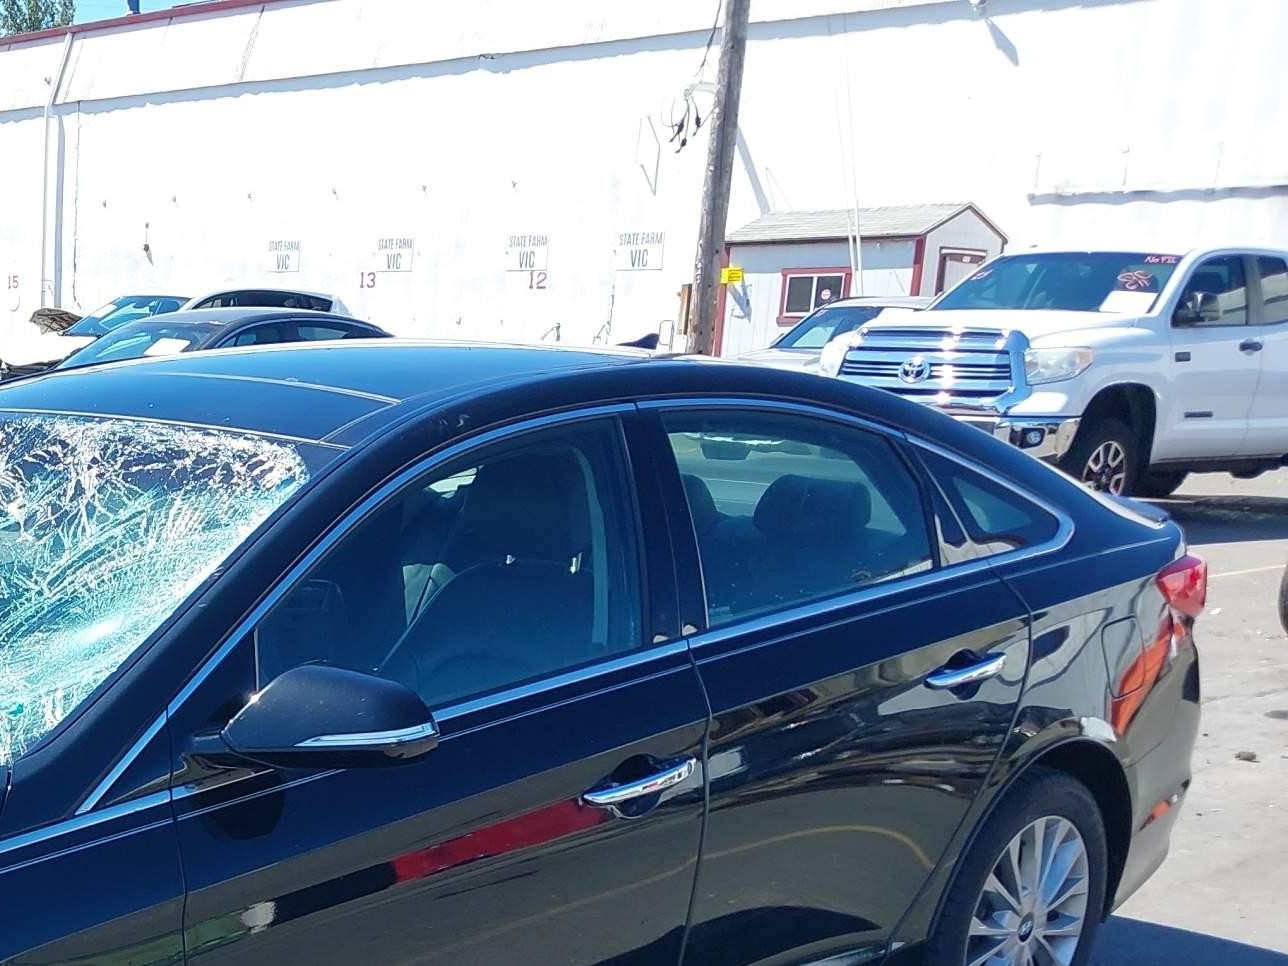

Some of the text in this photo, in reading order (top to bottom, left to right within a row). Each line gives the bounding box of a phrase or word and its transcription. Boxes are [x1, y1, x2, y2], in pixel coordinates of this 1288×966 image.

[268, 240, 283, 252] STATE
[378, 238, 412, 250] STATE FARM
[509, 234, 548, 248] STATE FARM
[619, 232, 663, 246] STATE FARM
[276, 254, 290, 270] VIC
[386, 252, 402, 270] VIC
[519, 250, 535, 269] VIC
[630, 248, 648, 268] VIC
[7, 275, 19, 290] 15
[359, 271, 376, 289] 13
[529, 270, 548, 290] 12
